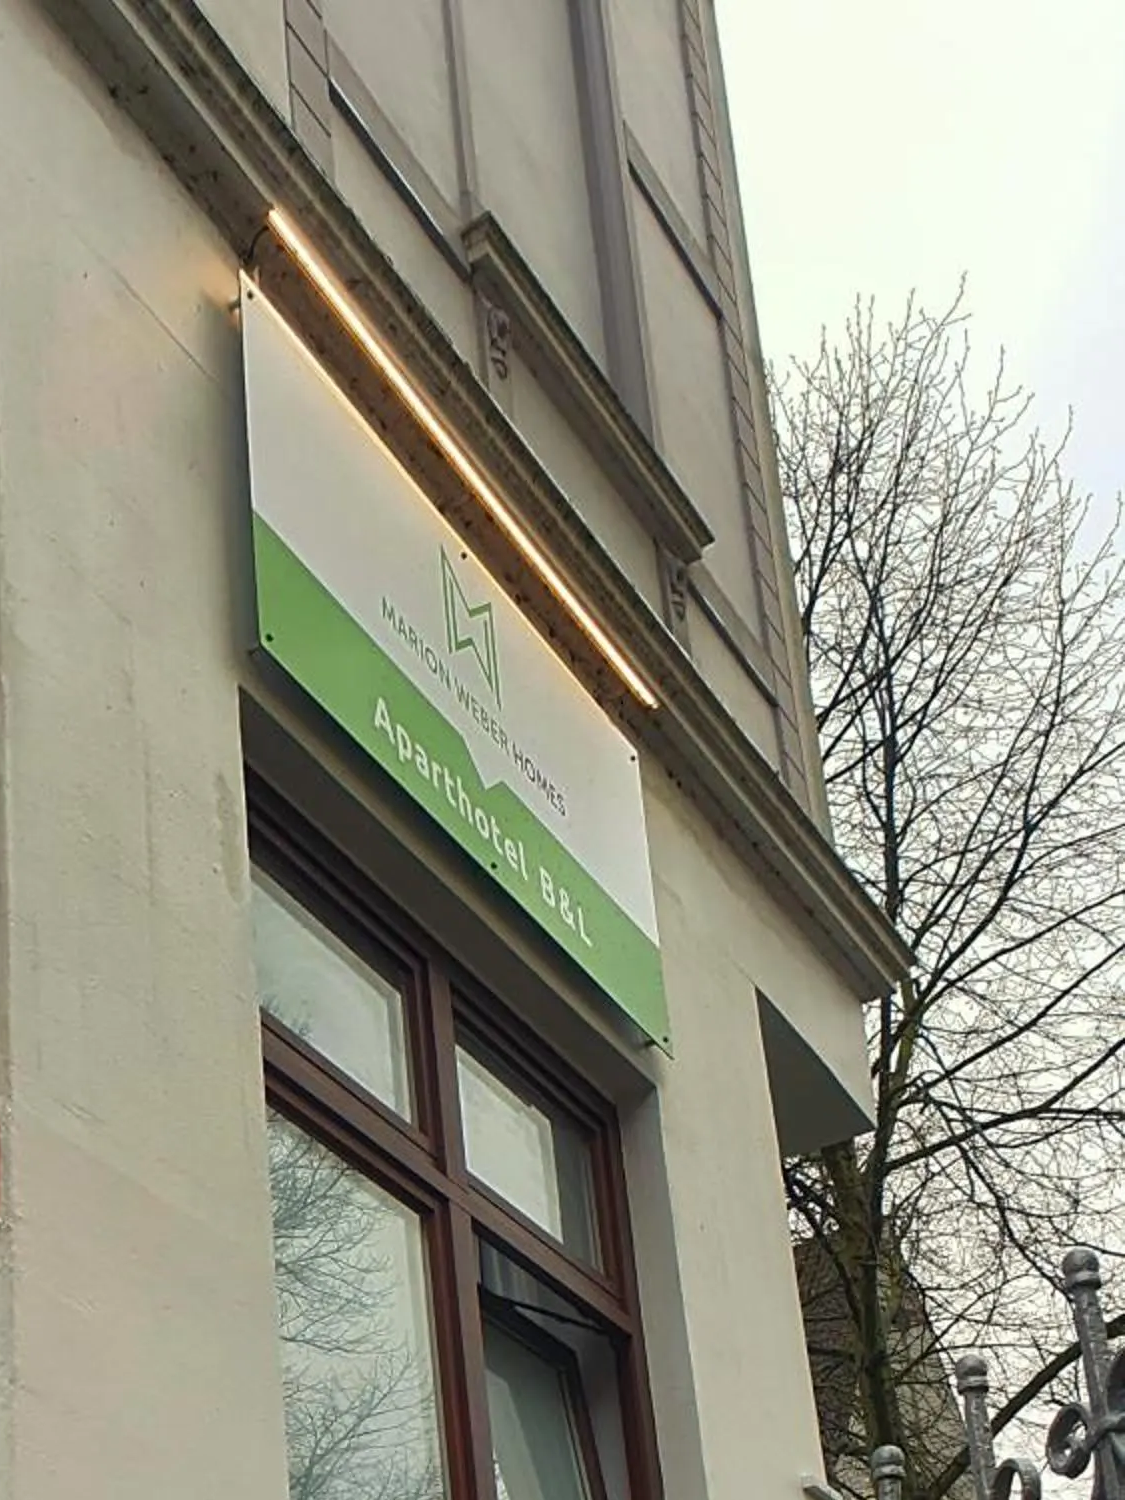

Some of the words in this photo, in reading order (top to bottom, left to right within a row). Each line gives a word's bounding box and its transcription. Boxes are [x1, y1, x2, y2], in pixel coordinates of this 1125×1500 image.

[375, 697, 528, 881] Aparthotel
[540, 866, 594, 946] B&L
[382, 596, 451, 691] MARION
[455, 676, 510, 755] WEBER
[513, 742, 566, 817] HOMES
